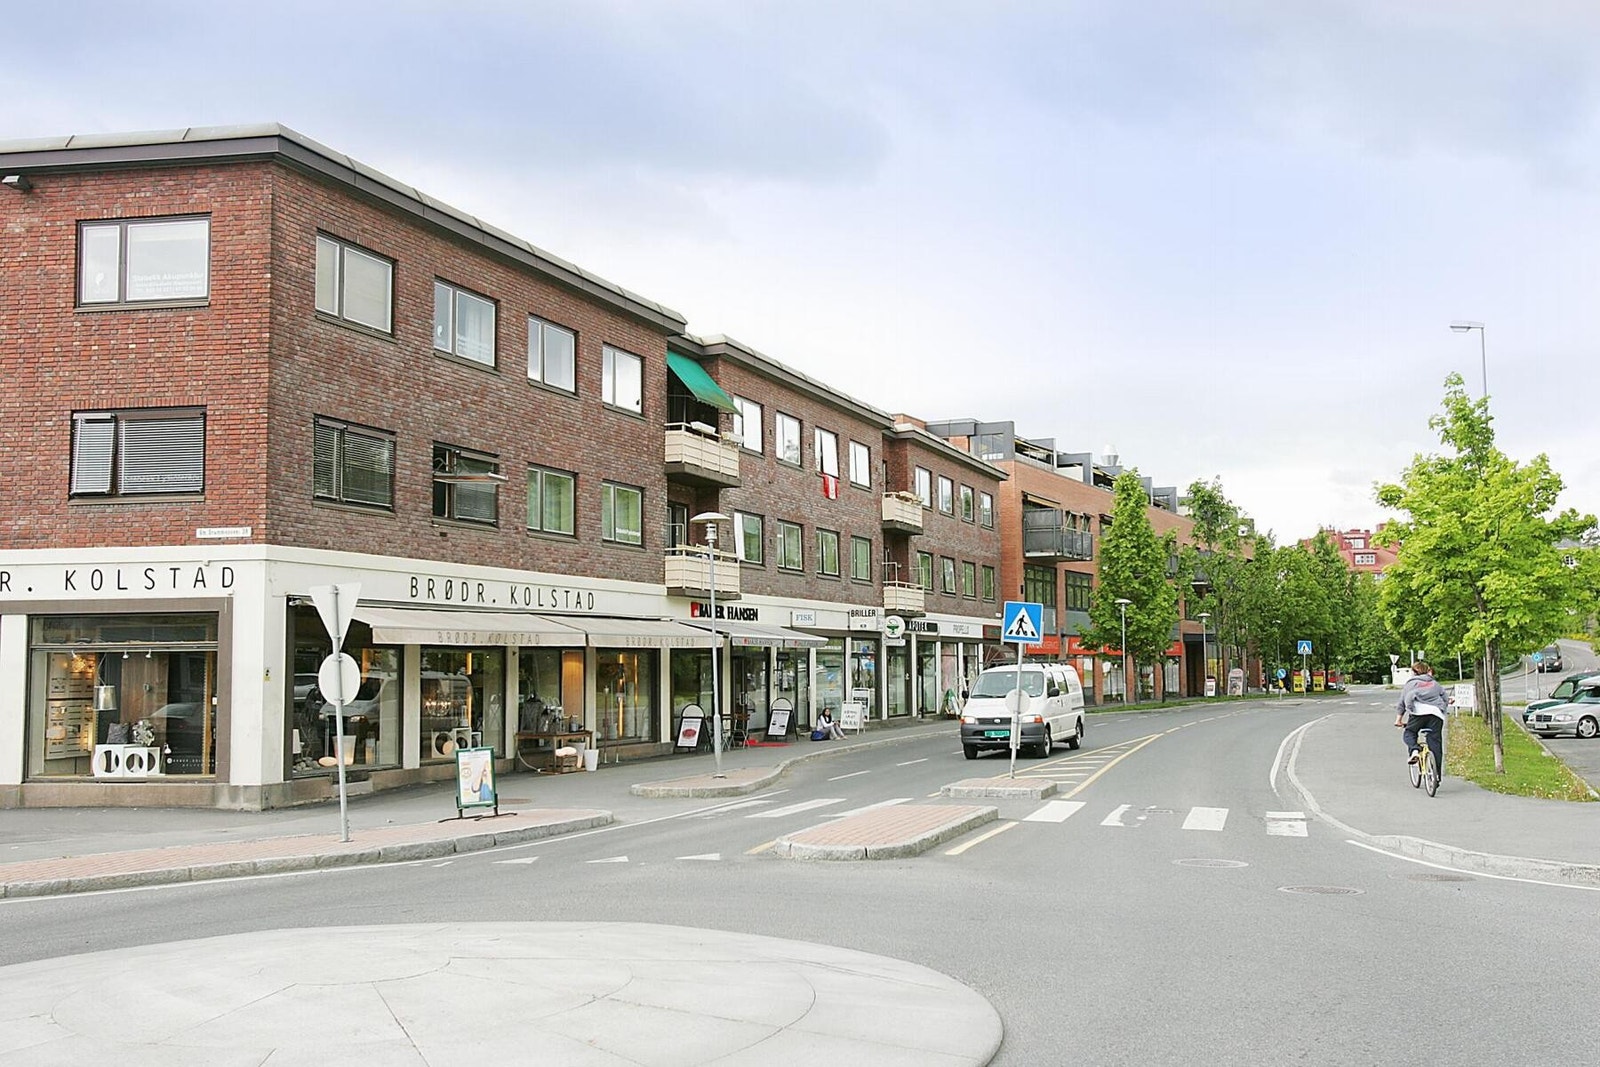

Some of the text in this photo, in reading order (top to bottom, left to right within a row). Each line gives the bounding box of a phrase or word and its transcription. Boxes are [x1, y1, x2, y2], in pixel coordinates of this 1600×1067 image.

[64, 567, 235, 592] KOLSTAD
[410, 576, 596, 611] BRØDR. KOLSTAD
[699, 602, 759, 622] BAER HANSEN
[795, 613, 814, 622] FISK
[850, 609, 877, 618] BRILLER
[487, 632, 541, 645] KOLSTAD
[659, 637, 696, 648] KOLSTAD
